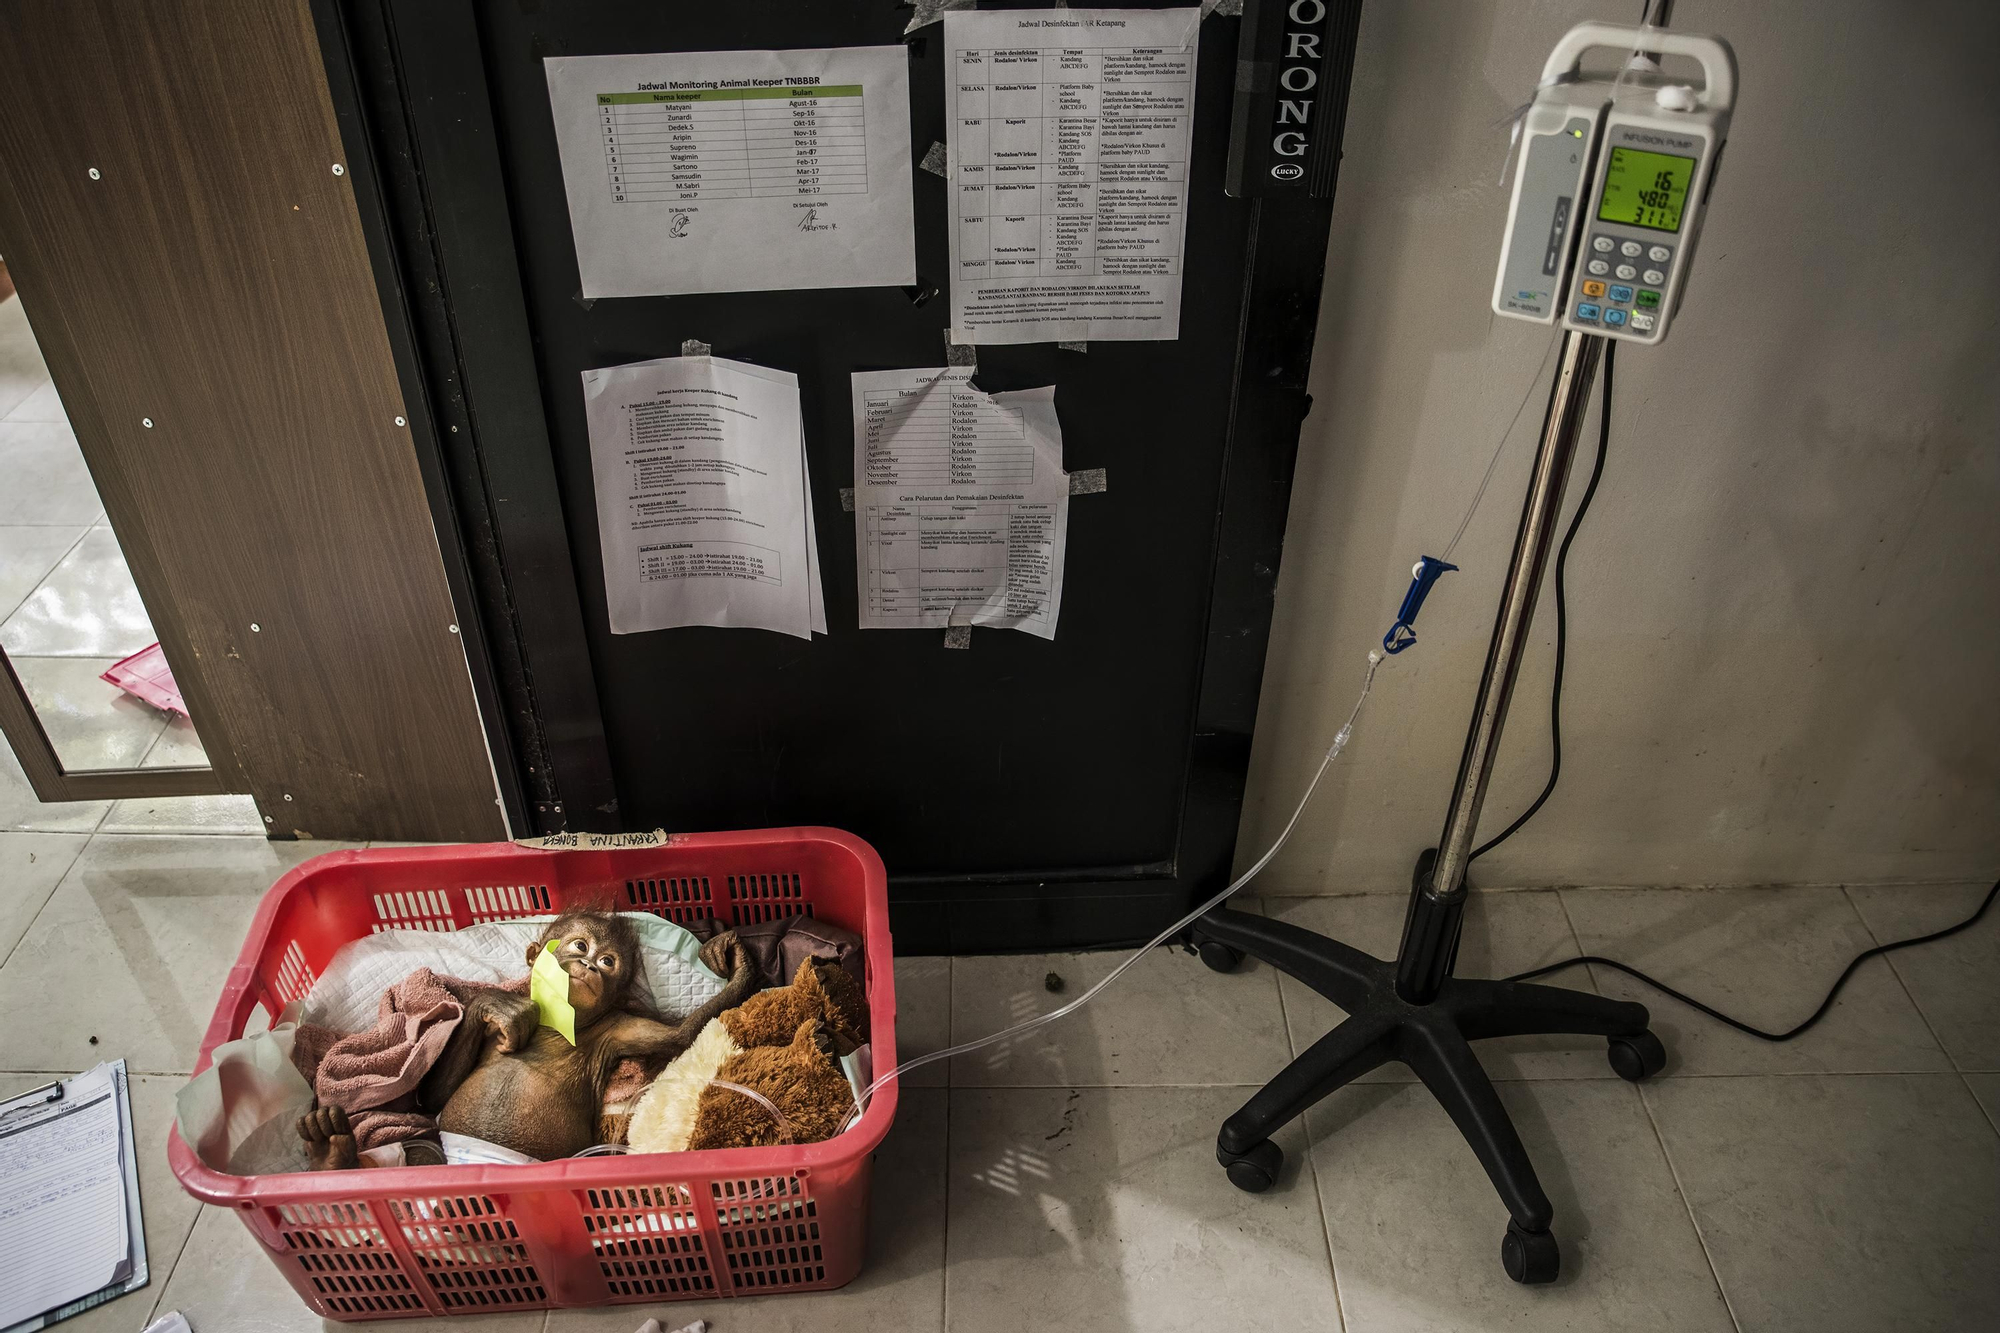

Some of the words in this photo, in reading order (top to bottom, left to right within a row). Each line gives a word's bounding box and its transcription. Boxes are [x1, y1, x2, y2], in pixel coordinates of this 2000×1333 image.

[1096, 20, 1126, 28] Ketapang
[637, 81, 668, 91] Jadwal
[670, 79, 718, 90] Monitoring
[720, 79, 751, 88] Animal
[752, 78, 783, 88] Keeper
[785, 77, 820, 86] TNBBBR
[676, 93, 701, 101] keeper
[789, 100, 817, 108] Agust-16
[673, 134, 692, 142] Aripin
[1623, 133, 1664, 145] INFUSION
[1666, 139, 1692, 148] PUMP
[670, 144, 697, 152] Supreno
[671, 153, 698, 161] Wagimin
[1655, 171, 1674, 191] 16
[676, 182, 700, 190] M.Sabri
[1639, 190, 1669, 209] 480
[868, 424, 883, 432] April
[543, 835, 578, 846] BONEKA
[590, 833, 659, 846] KARANTINA
